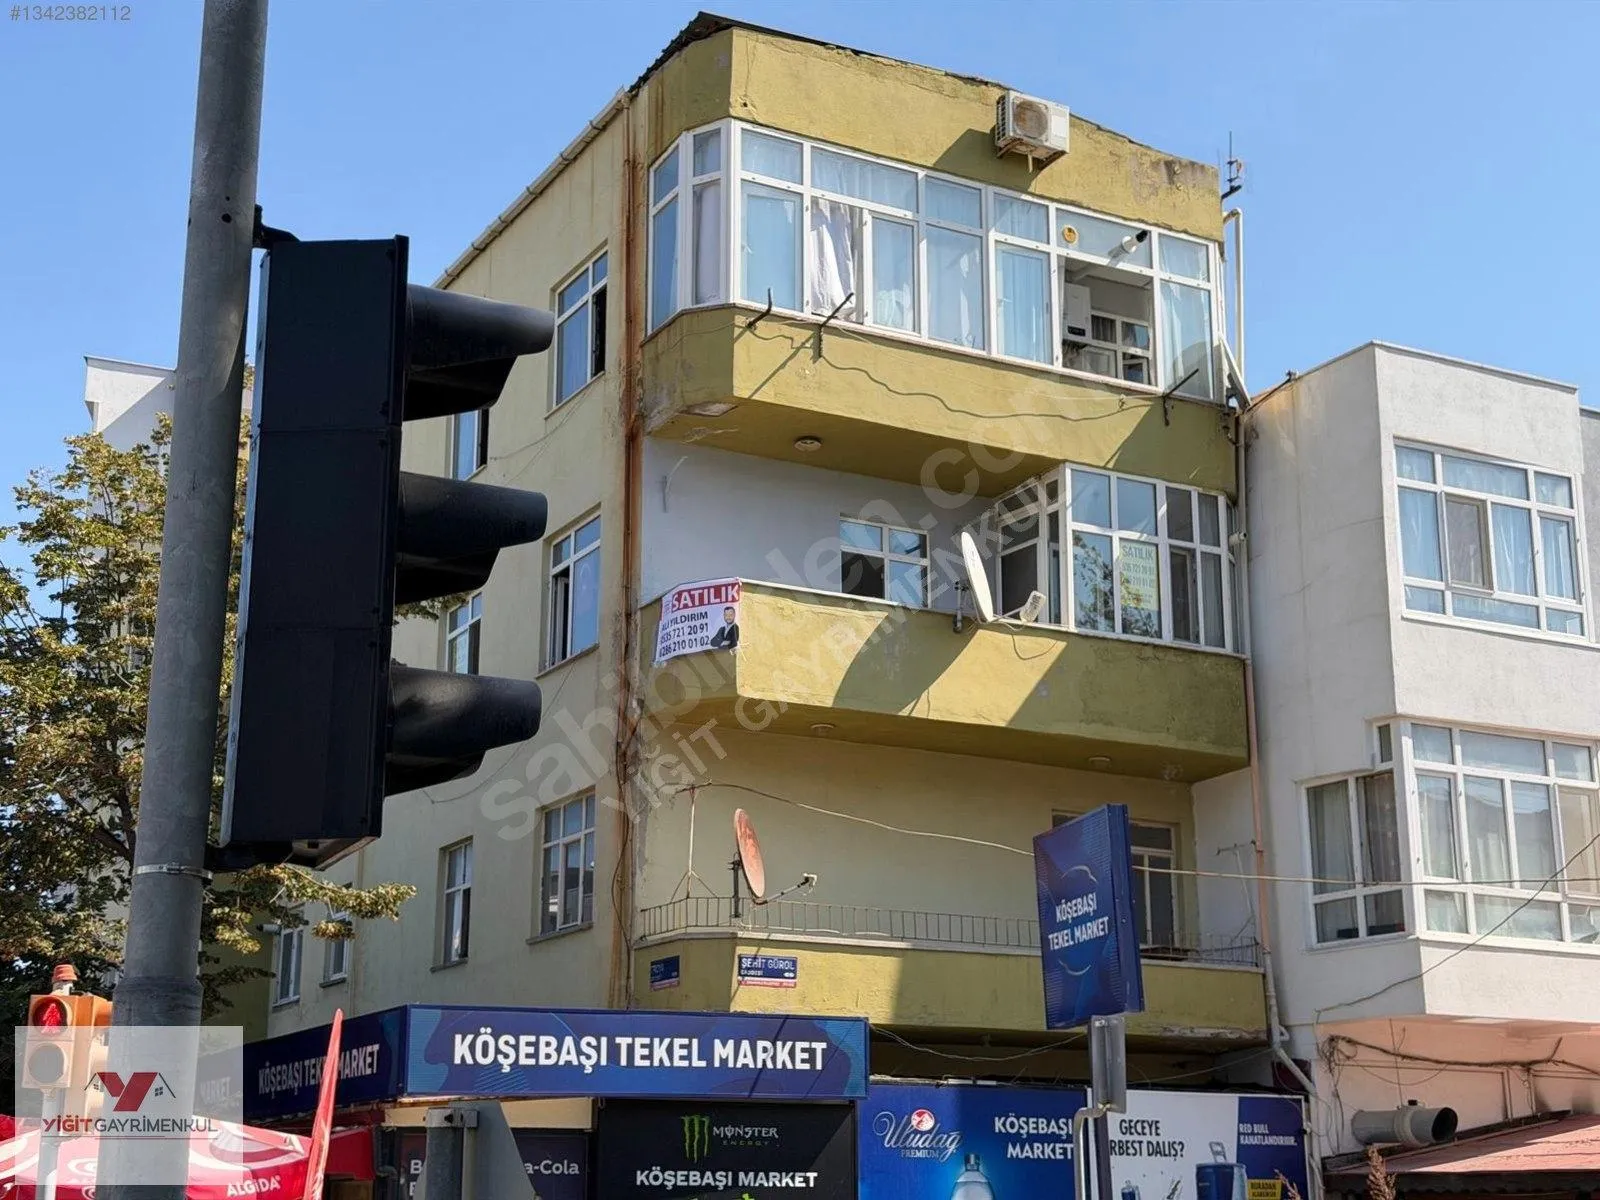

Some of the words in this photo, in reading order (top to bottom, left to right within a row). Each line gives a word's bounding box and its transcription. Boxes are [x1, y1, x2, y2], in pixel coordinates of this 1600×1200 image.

[671, 583, 740, 611] SATILIK
[670, 611, 709, 627] YILDIRIM
[672, 627, 685, 639] 721
[687, 624, 698, 636] 20
[699, 622, 709, 633] 91
[672, 639, 687, 652] 210
[688, 638, 698, 649] 01
[699, 636, 710, 646] 02
[1055, 892, 1097, 923] KÖŞEBAŞI
[1048, 931, 1074, 950] TEKEL
[1074, 916, 1110, 944] MARKET
[453, 1027, 607, 1073] KÖŞEBAŞI
[615, 1037, 706, 1067] TEKEL
[714, 1039, 827, 1070] MARKET
[258, 1060, 302, 1099] KÖŞEBAŞI
[303, 1055, 327, 1087] TEK
[712, 1125, 779, 1139] MONSTER
[994, 1113, 1072, 1139] KÖŞEBAŞI
[1119, 1119, 1161, 1136] GECEYE
[1239, 1123, 1252, 1134] RED
[1253, 1124, 1269, 1134] BULL
[873, 1111, 965, 1162] Uludağ
[901, 1149, 940, 1158] PREMIUM
[1007, 1142, 1074, 1160] MARKET
[1110, 1139, 1143, 1157] RBEST
[1146, 1141, 1185, 1162] DALIŞ?
[524, 1160, 580, 1175] a-Cola
[636, 1166, 732, 1190] KÖŞEBAŞI
[738, 1171, 818, 1187] MARKET
